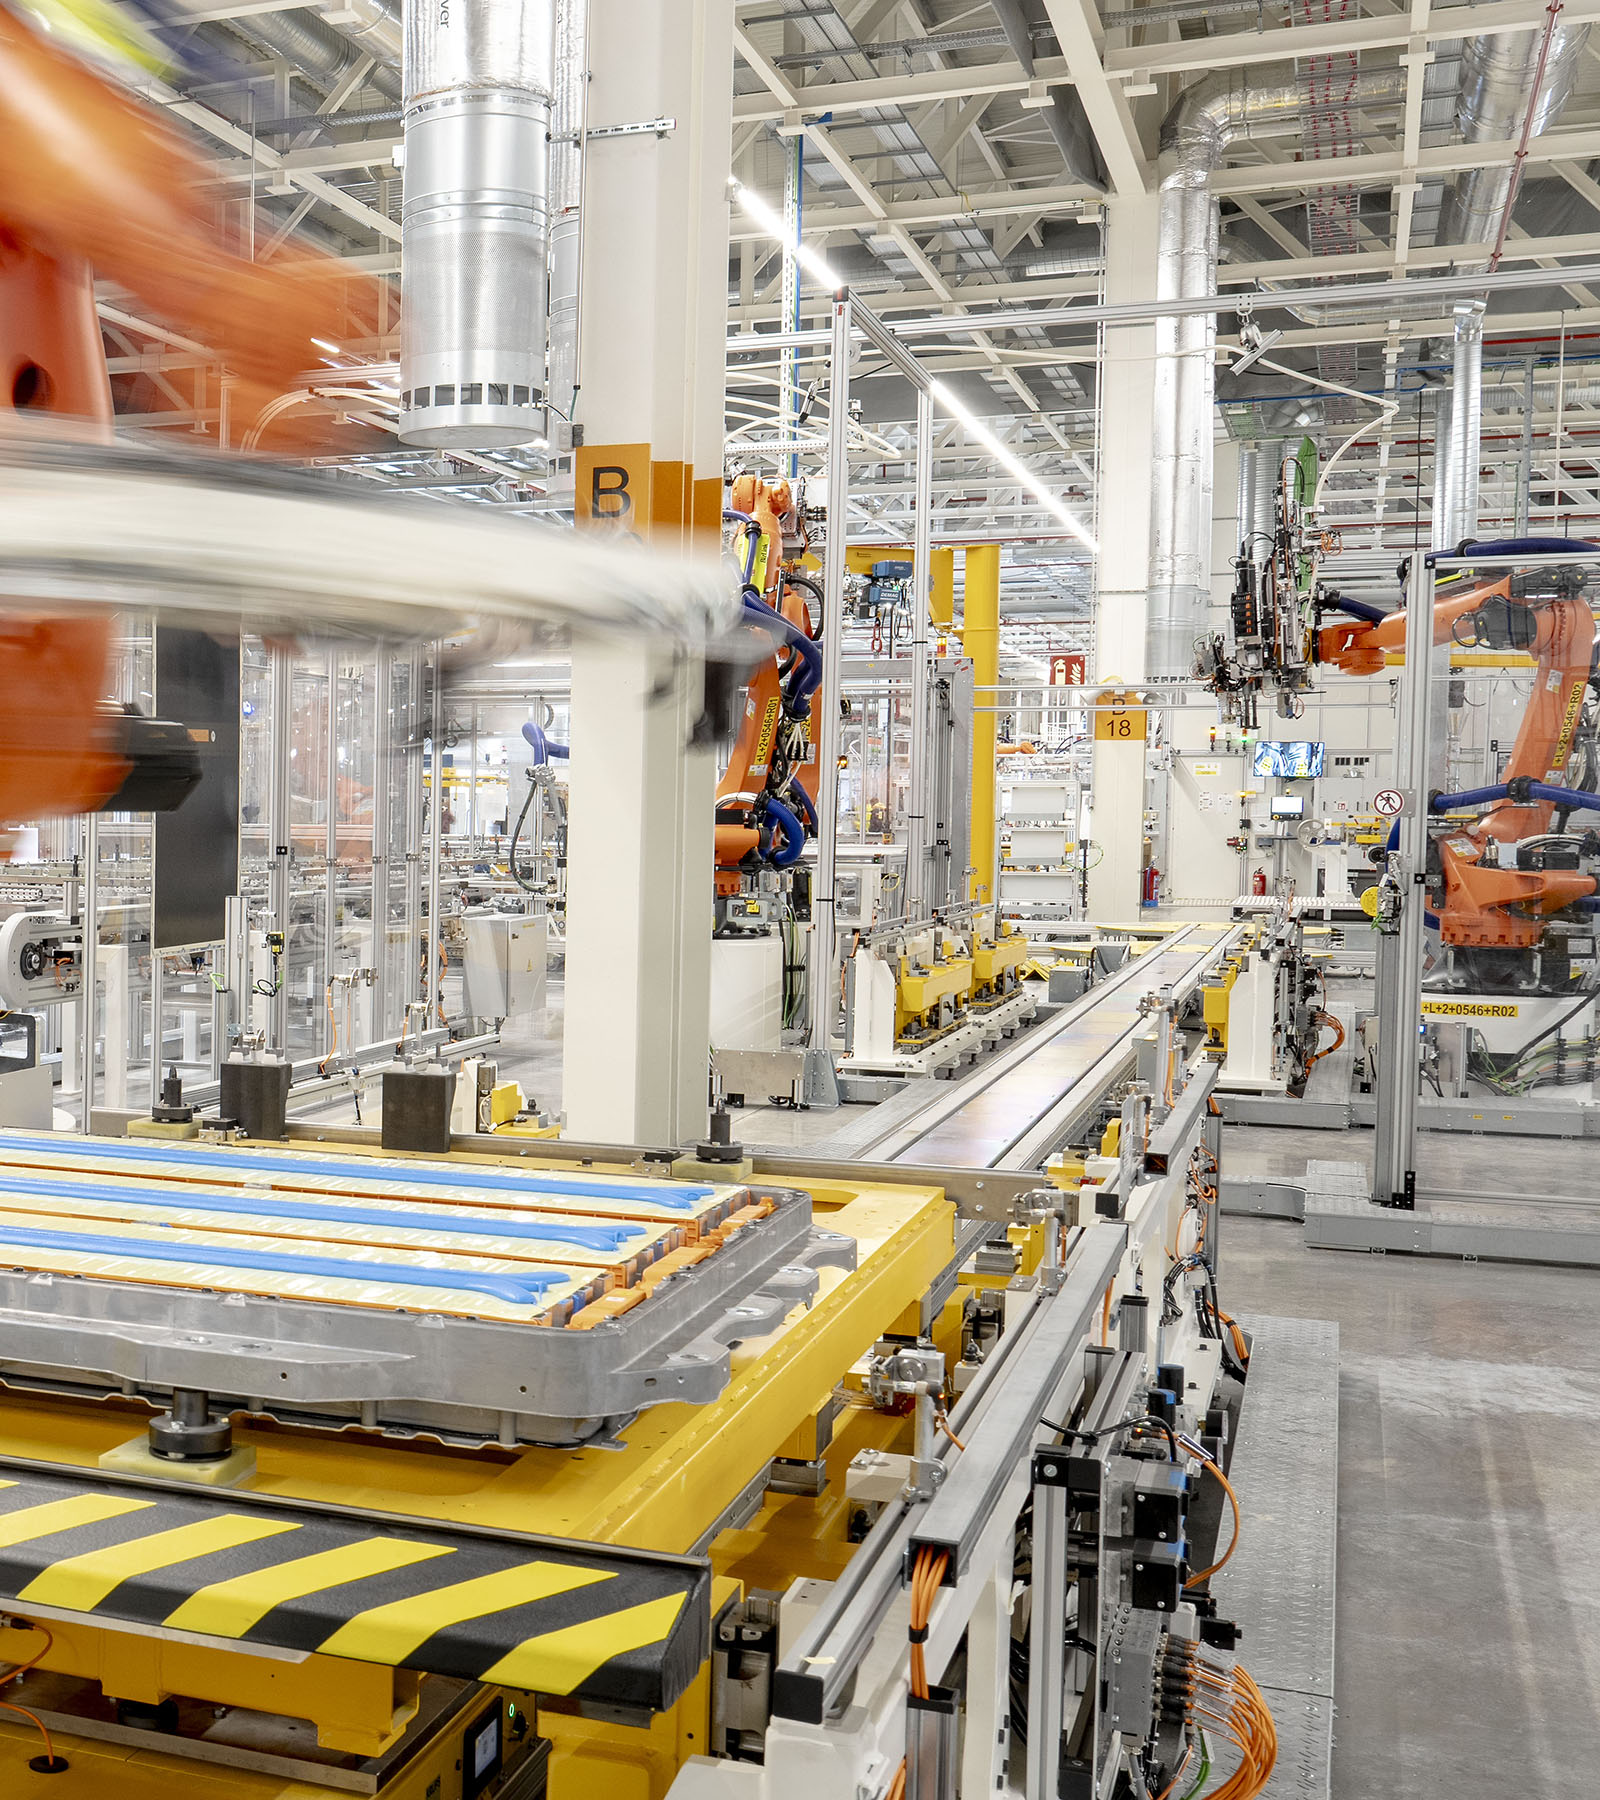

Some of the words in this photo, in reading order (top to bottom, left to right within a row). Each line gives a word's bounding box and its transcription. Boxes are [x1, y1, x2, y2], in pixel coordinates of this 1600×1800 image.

[592, 466, 631, 518] B
[756, 698, 779, 762] +L+2+0546+R01
[1106, 719, 1131, 737] 18
[1554, 684, 1583, 764] +L+2+0546+R02
[1423, 1003, 1515, 1017] +L+2+0546+R02
